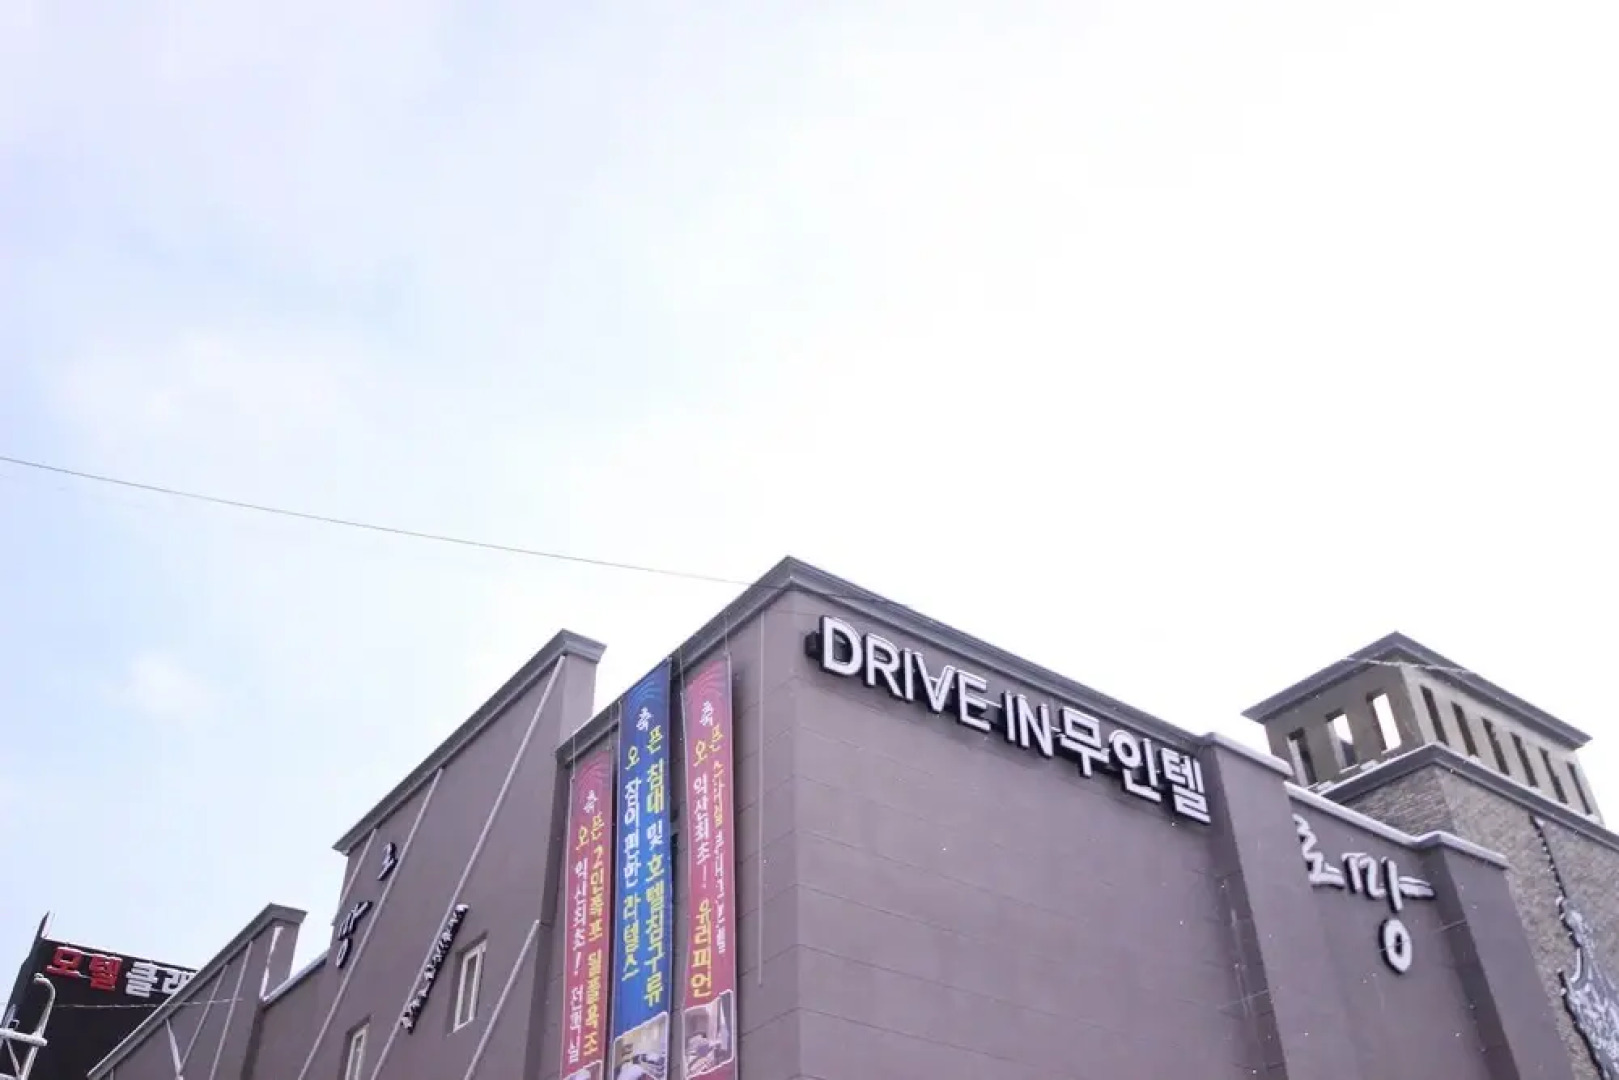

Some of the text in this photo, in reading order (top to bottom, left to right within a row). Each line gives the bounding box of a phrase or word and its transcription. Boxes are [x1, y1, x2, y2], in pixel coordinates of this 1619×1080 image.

[820, 615, 1211, 823] DRIVE IN 무인텔
[45, 945, 123, 991] 모텔
